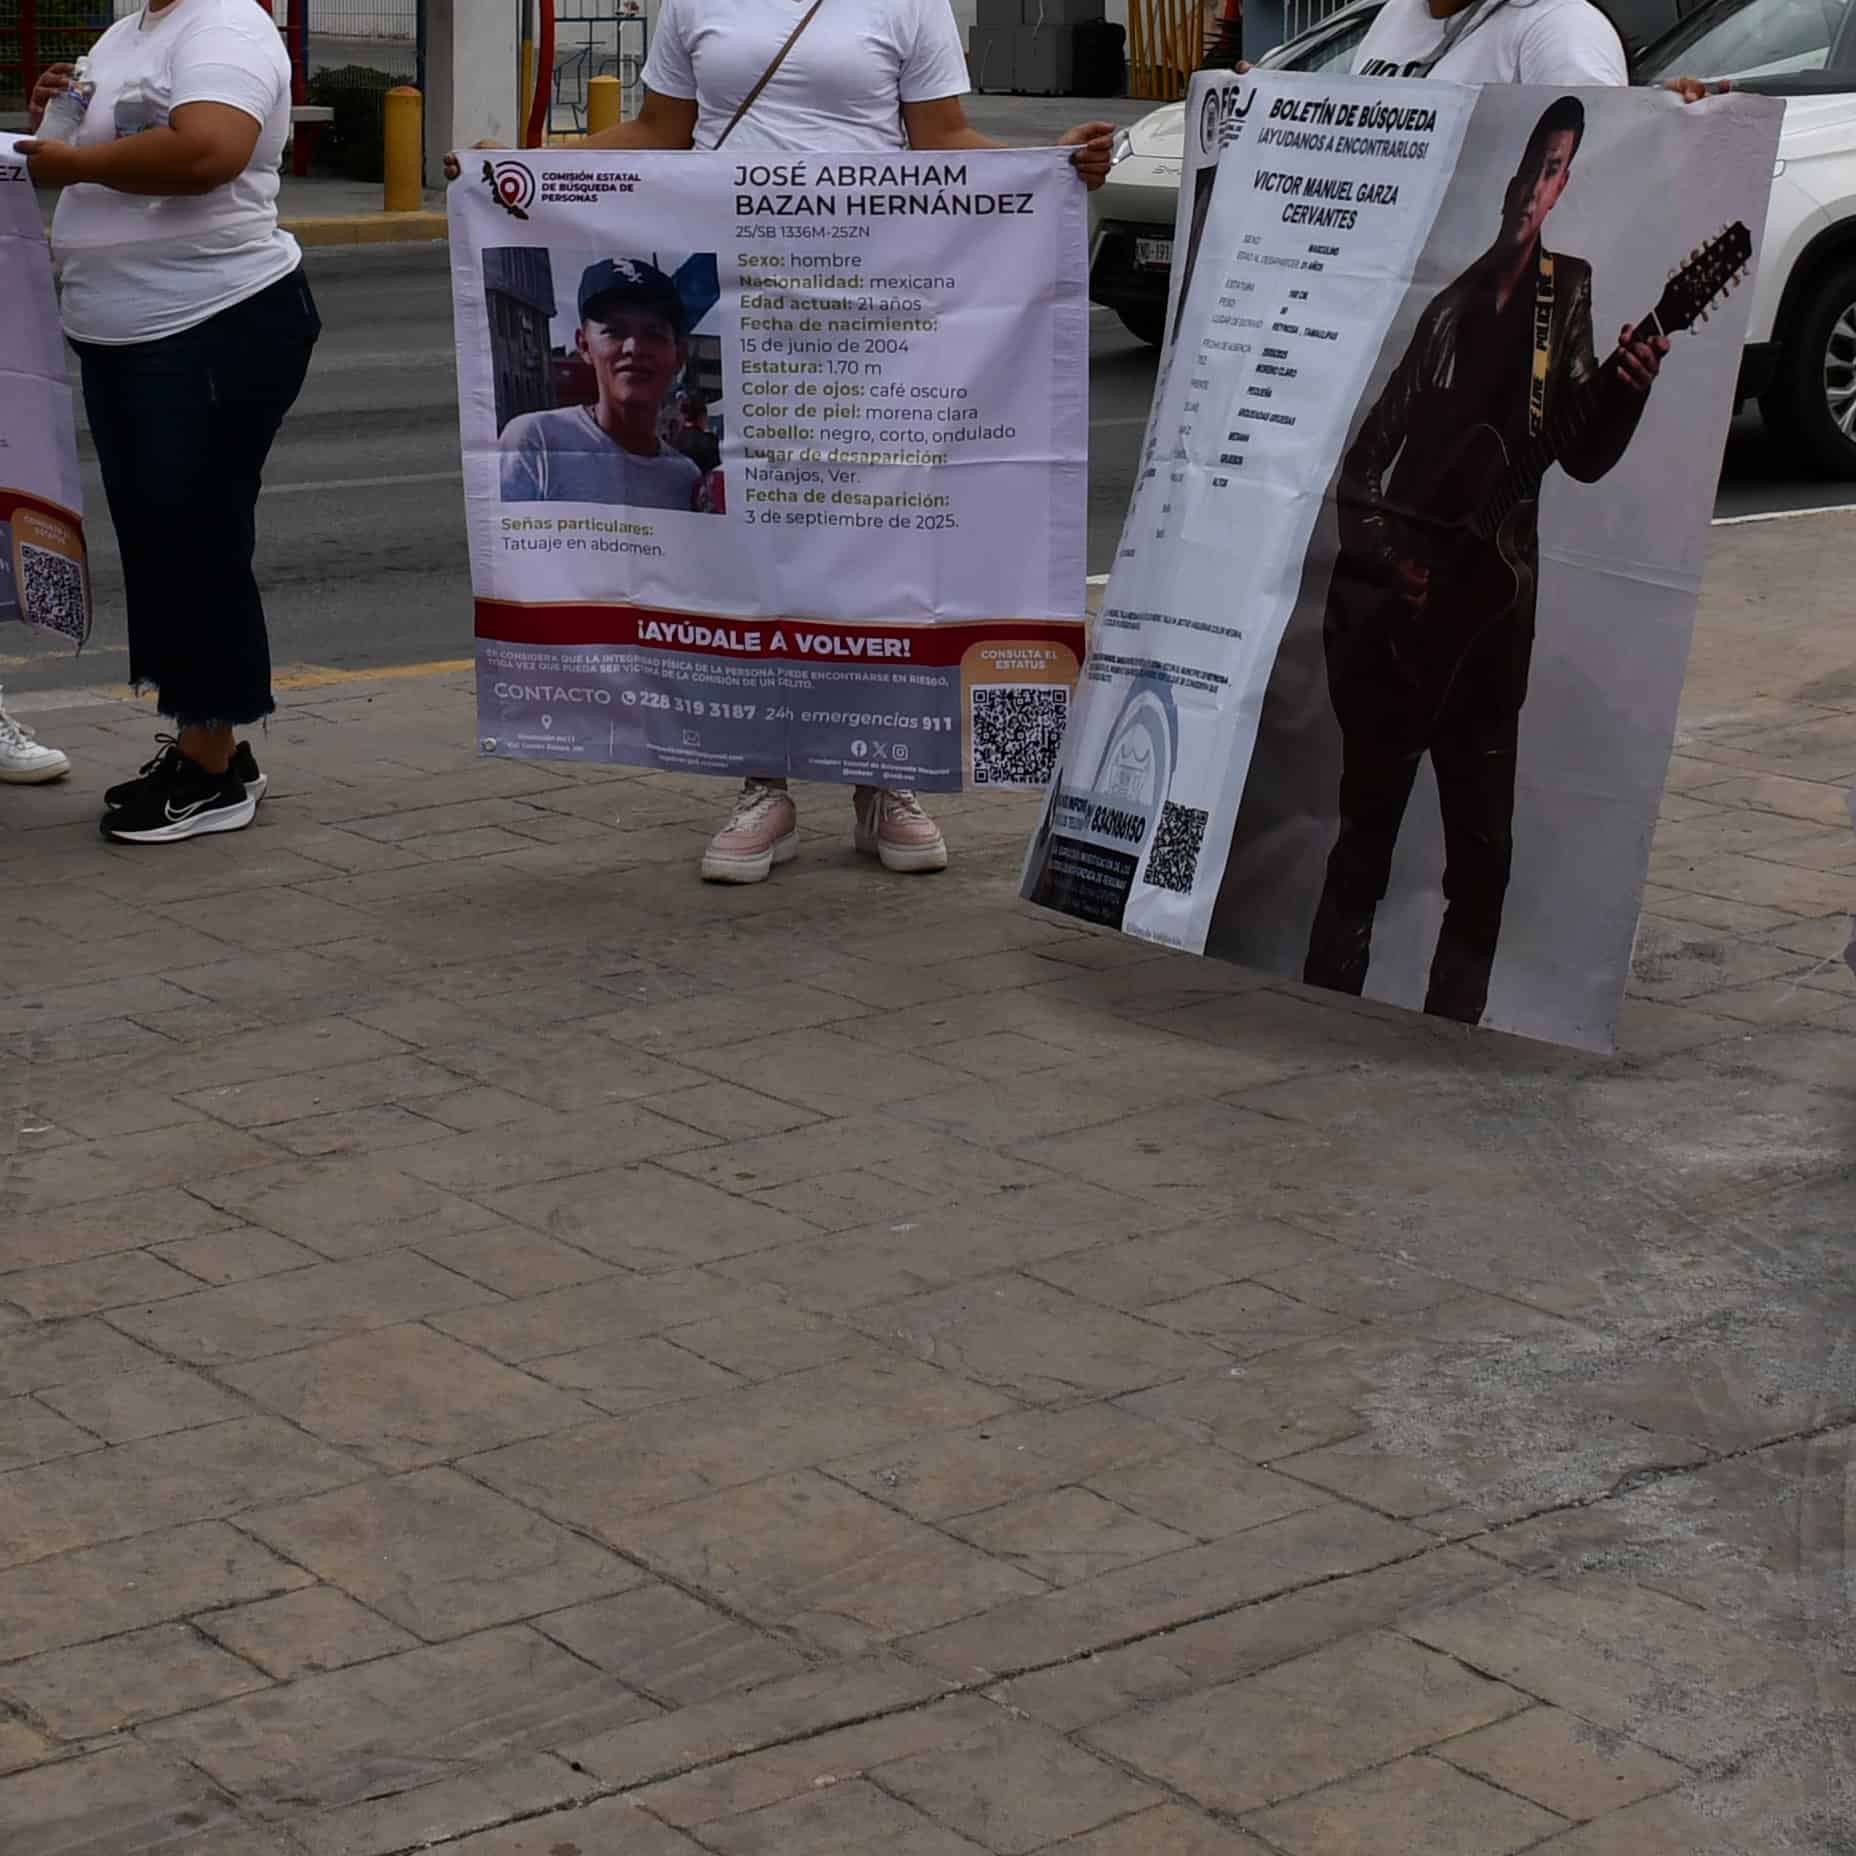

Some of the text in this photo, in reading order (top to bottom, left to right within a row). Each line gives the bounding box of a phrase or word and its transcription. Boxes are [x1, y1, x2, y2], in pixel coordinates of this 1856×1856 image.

[1269, 96, 1438, 133] BOLETÍN DE BÚSQUEDA
[1258, 127, 1324, 152] ¡AYUDANOS
[1325, 135, 1334, 151] A
[1335, 138, 1429, 160] ENCONTRARLOS!
[596, 172, 642, 182] ESTATAL
[734, 161, 967, 187] JOSÉ ABRAHAM
[541, 182, 557, 192] DE
[619, 183, 635, 193] DE
[1253, 168, 1399, 206] VICTOR MANUEL GARZA
[541, 193, 599, 203] PERSONAS
[735, 189, 1034, 216] BAZAN HERNÁNDEZ
[1281, 203, 1359, 230] CERVANTES
[737, 252, 862, 268] Sexo: hombre
[738, 274, 956, 290] Nacionalidad: mexicana
[740, 294, 922, 312] Edad actual: 21 años
[740, 316, 938, 333] Fecha de nacimiento:
[740, 337, 909, 355] 15 de junio de 2004
[741, 359, 882, 376] Estatura: 1.70 m
[742, 381, 968, 400] Color de ojos: café oscuro
[742, 402, 979, 422] Color de piel: morena clara
[743, 424, 1016, 444] Cabello: negro, corto, ondulado
[744, 446, 948, 467] Lugar de desaparición:
[745, 467, 861, 486] Naranjos, Ver.
[745, 488, 950, 509] Fecha de desaparición:
[501, 517, 655, 537] Señas particulares:
[745, 509, 960, 531] 3 de septiembre de 2025.
[502, 536, 666, 558] Tatuaje en abdomen.
[638, 618, 912, 658] ¡AYÚDALE A VOLVER!
[981, 649, 1042, 660] CONSULTA
[994, 659, 1047, 671] ESTATUS
[494, 682, 952, 732] CONTACTO 228 319 3187 24h emergencias 911
